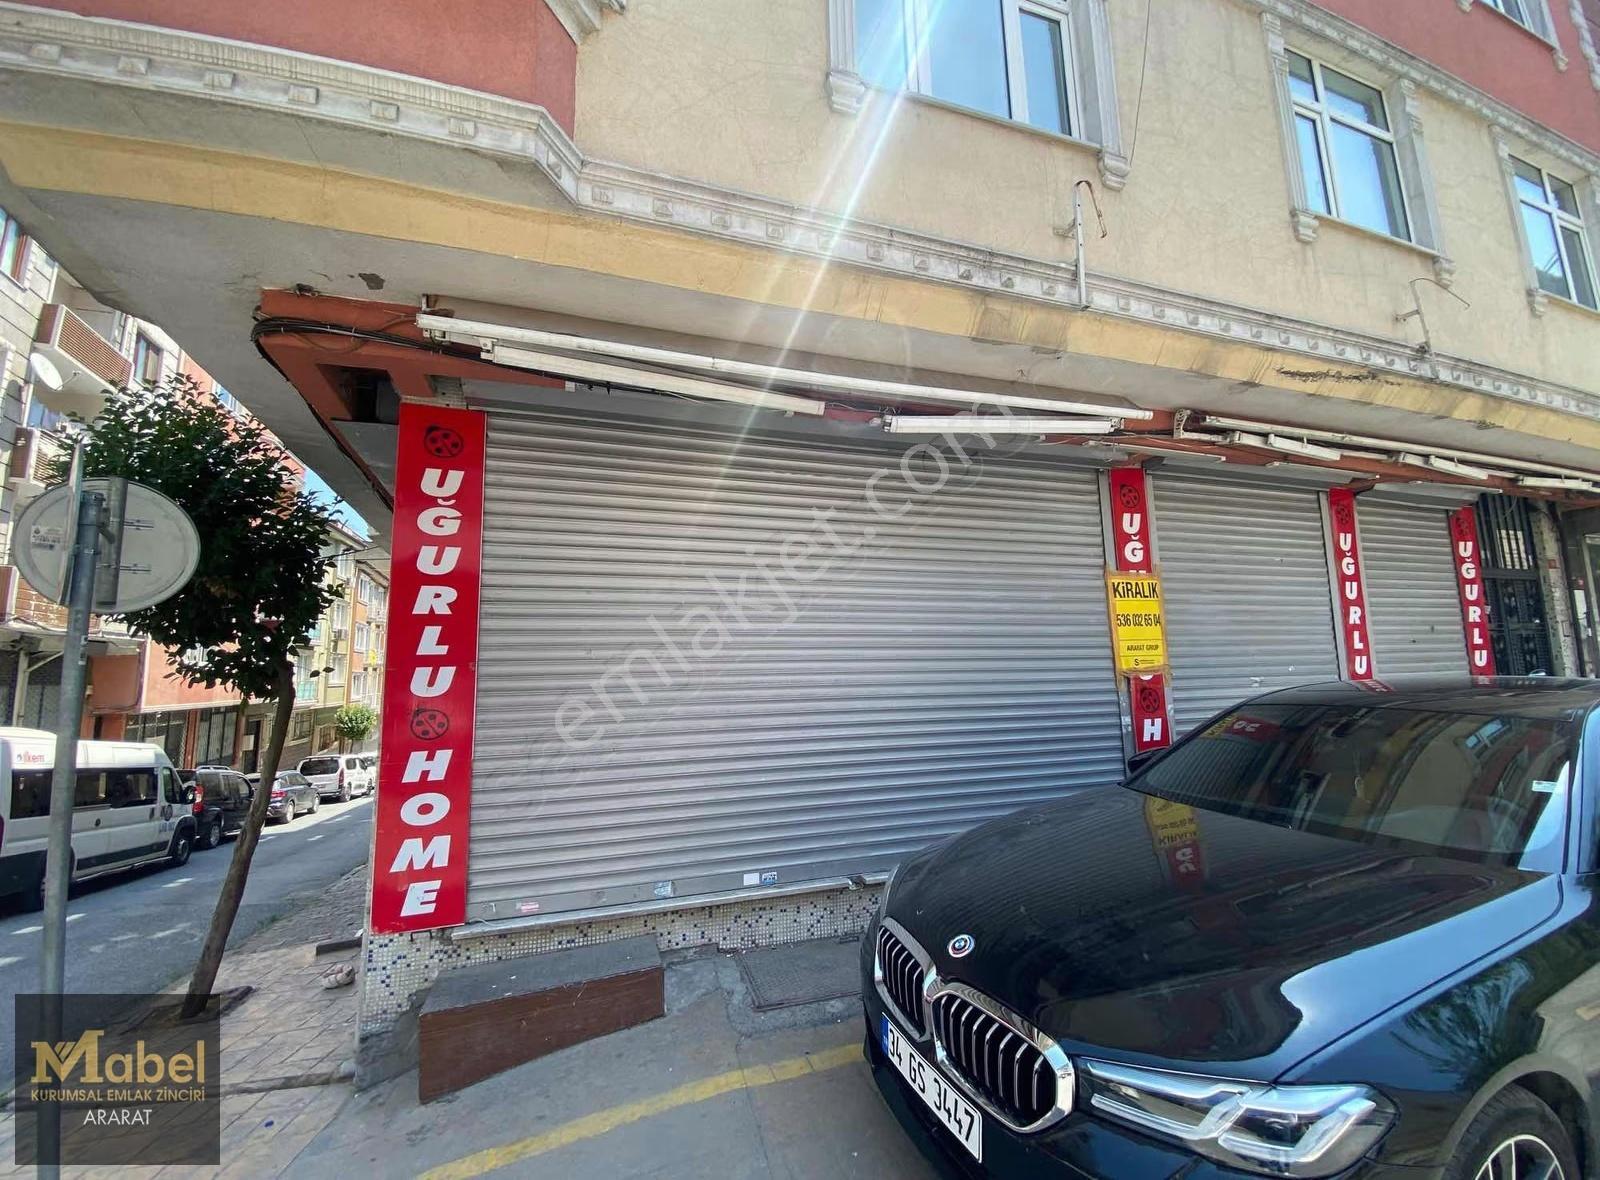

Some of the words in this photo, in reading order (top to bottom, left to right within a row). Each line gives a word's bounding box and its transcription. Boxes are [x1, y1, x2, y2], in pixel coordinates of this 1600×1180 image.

[410, 467, 465, 698] UĞURLU
[1116, 613, 1131, 627] 536
[1339, 532, 1368, 675] UĞURLU
[1458, 541, 1488, 667] UĞURLU
[389, 749, 454, 917] HOME
[889, 1027, 902, 1067] 34
[909, 1051, 926, 1095] GS
[933, 1076, 975, 1142] 3447
